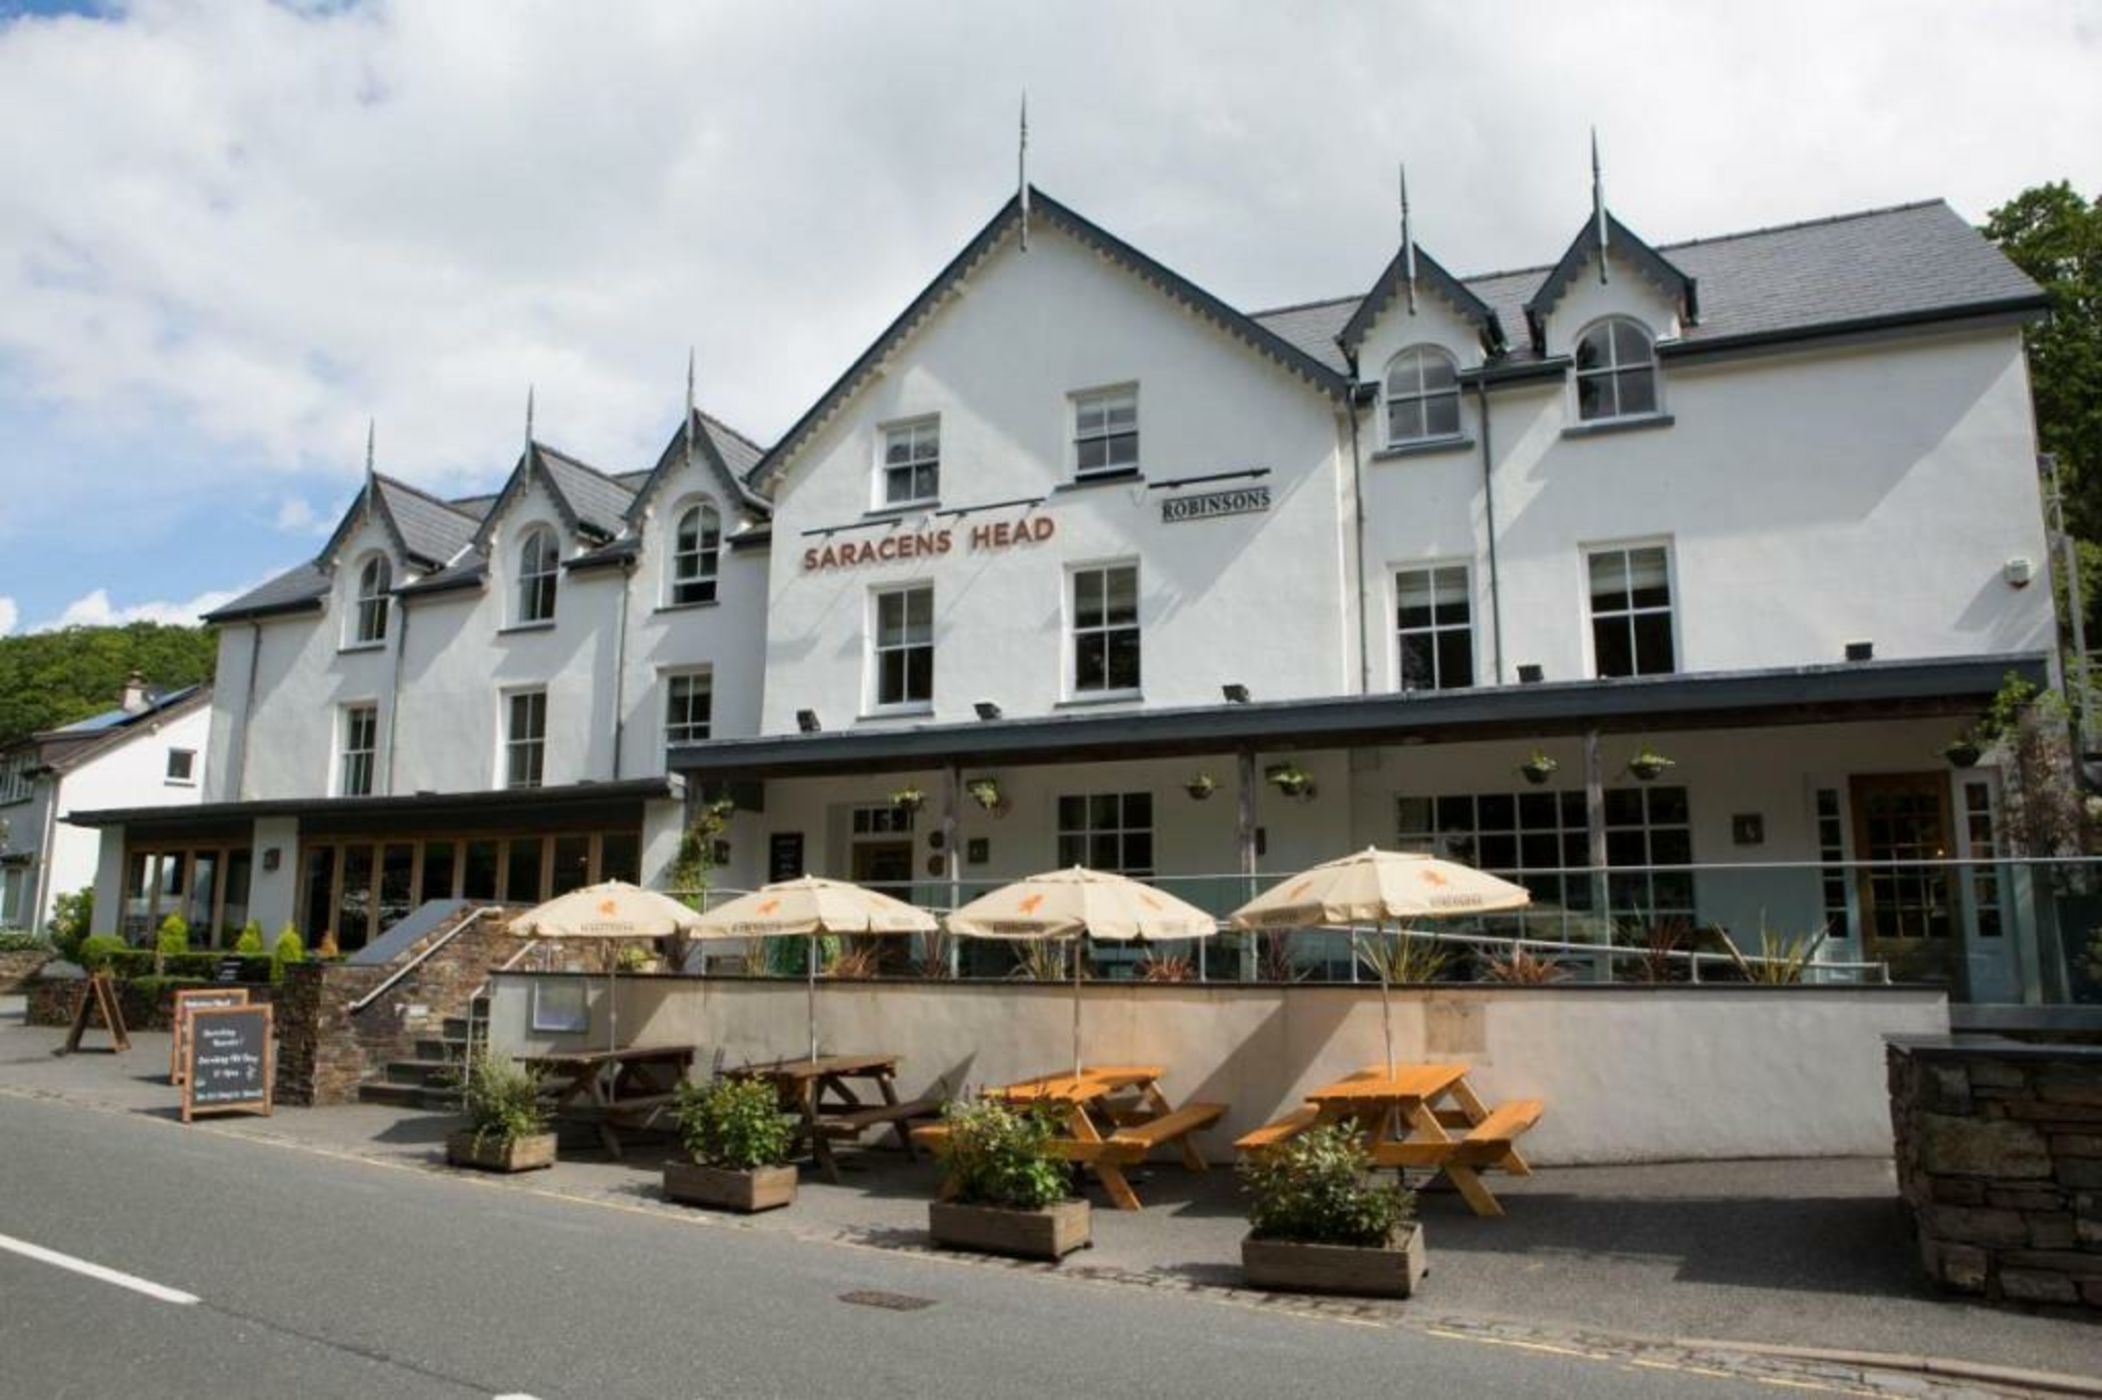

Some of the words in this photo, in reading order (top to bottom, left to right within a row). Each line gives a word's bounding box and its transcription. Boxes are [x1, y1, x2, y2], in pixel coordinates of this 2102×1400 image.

[1162, 491, 1271, 520] ROBINSONS
[804, 530, 952, 571] SARACENS
[971, 517, 1055, 550] HEAD
